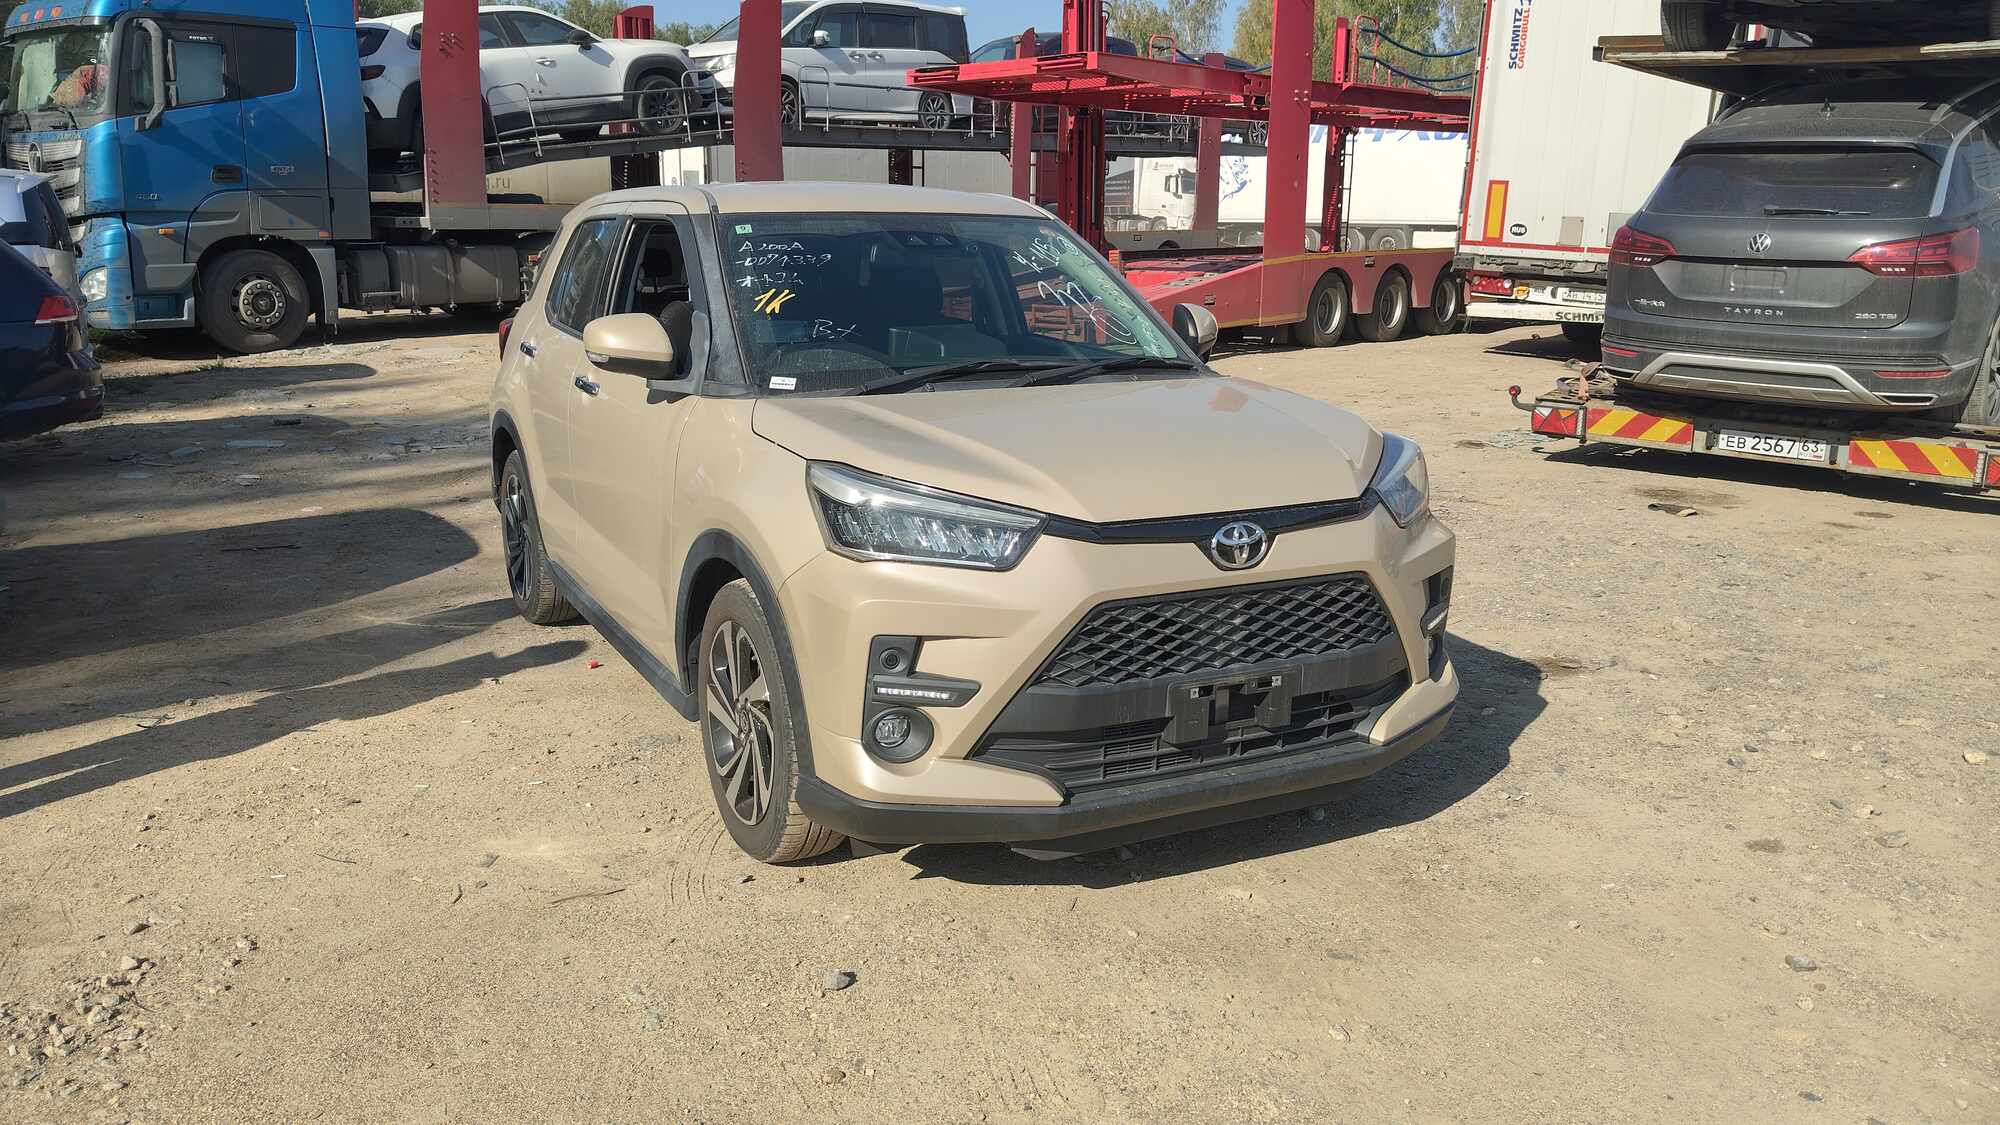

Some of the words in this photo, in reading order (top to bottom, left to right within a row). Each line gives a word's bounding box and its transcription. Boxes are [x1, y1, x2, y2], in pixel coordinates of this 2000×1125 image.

[1508, 7, 1523, 69] SCHMITZ
[1517, 7, 1531, 69] CARGOBULL
[1723, 306, 1784, 317] TAYRON
[1750, 435, 1797, 456] 2567
[1801, 439, 1819, 453] 63
